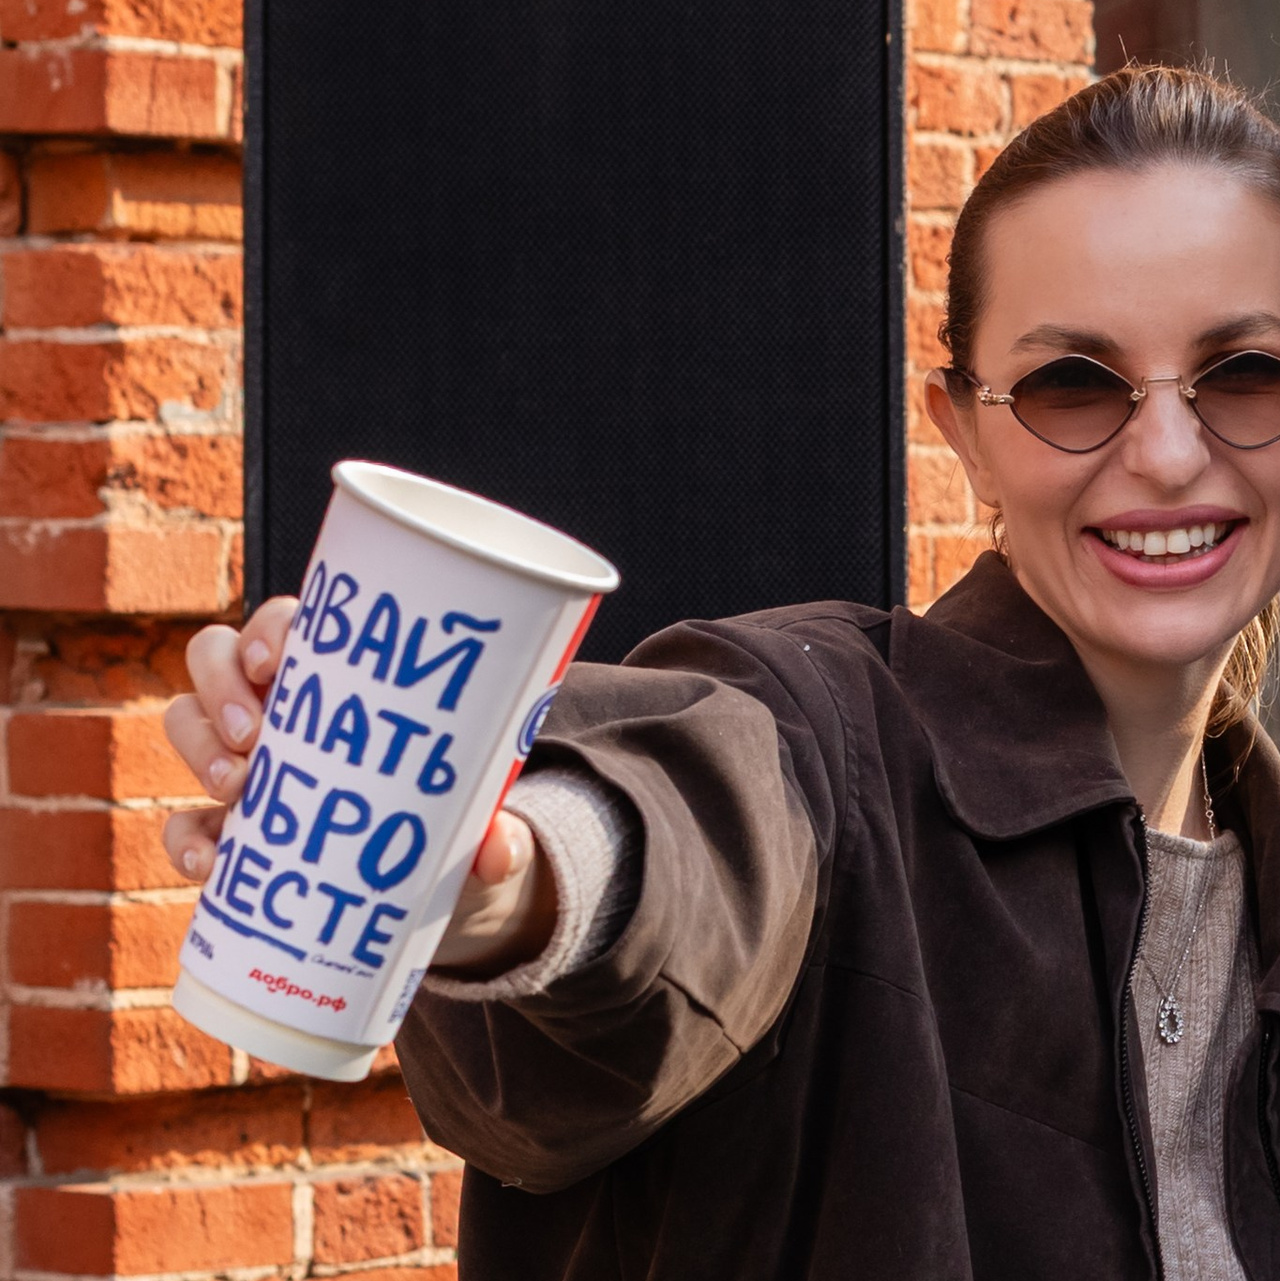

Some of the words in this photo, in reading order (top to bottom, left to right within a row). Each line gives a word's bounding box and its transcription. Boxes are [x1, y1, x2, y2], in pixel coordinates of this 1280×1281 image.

[292, 561, 501, 712] АВАЙ
[267, 656, 457, 795] ЕЛАТЬ
[231, 745, 427, 892] ОБРО
[249, 968, 347, 1012] добро.рф
